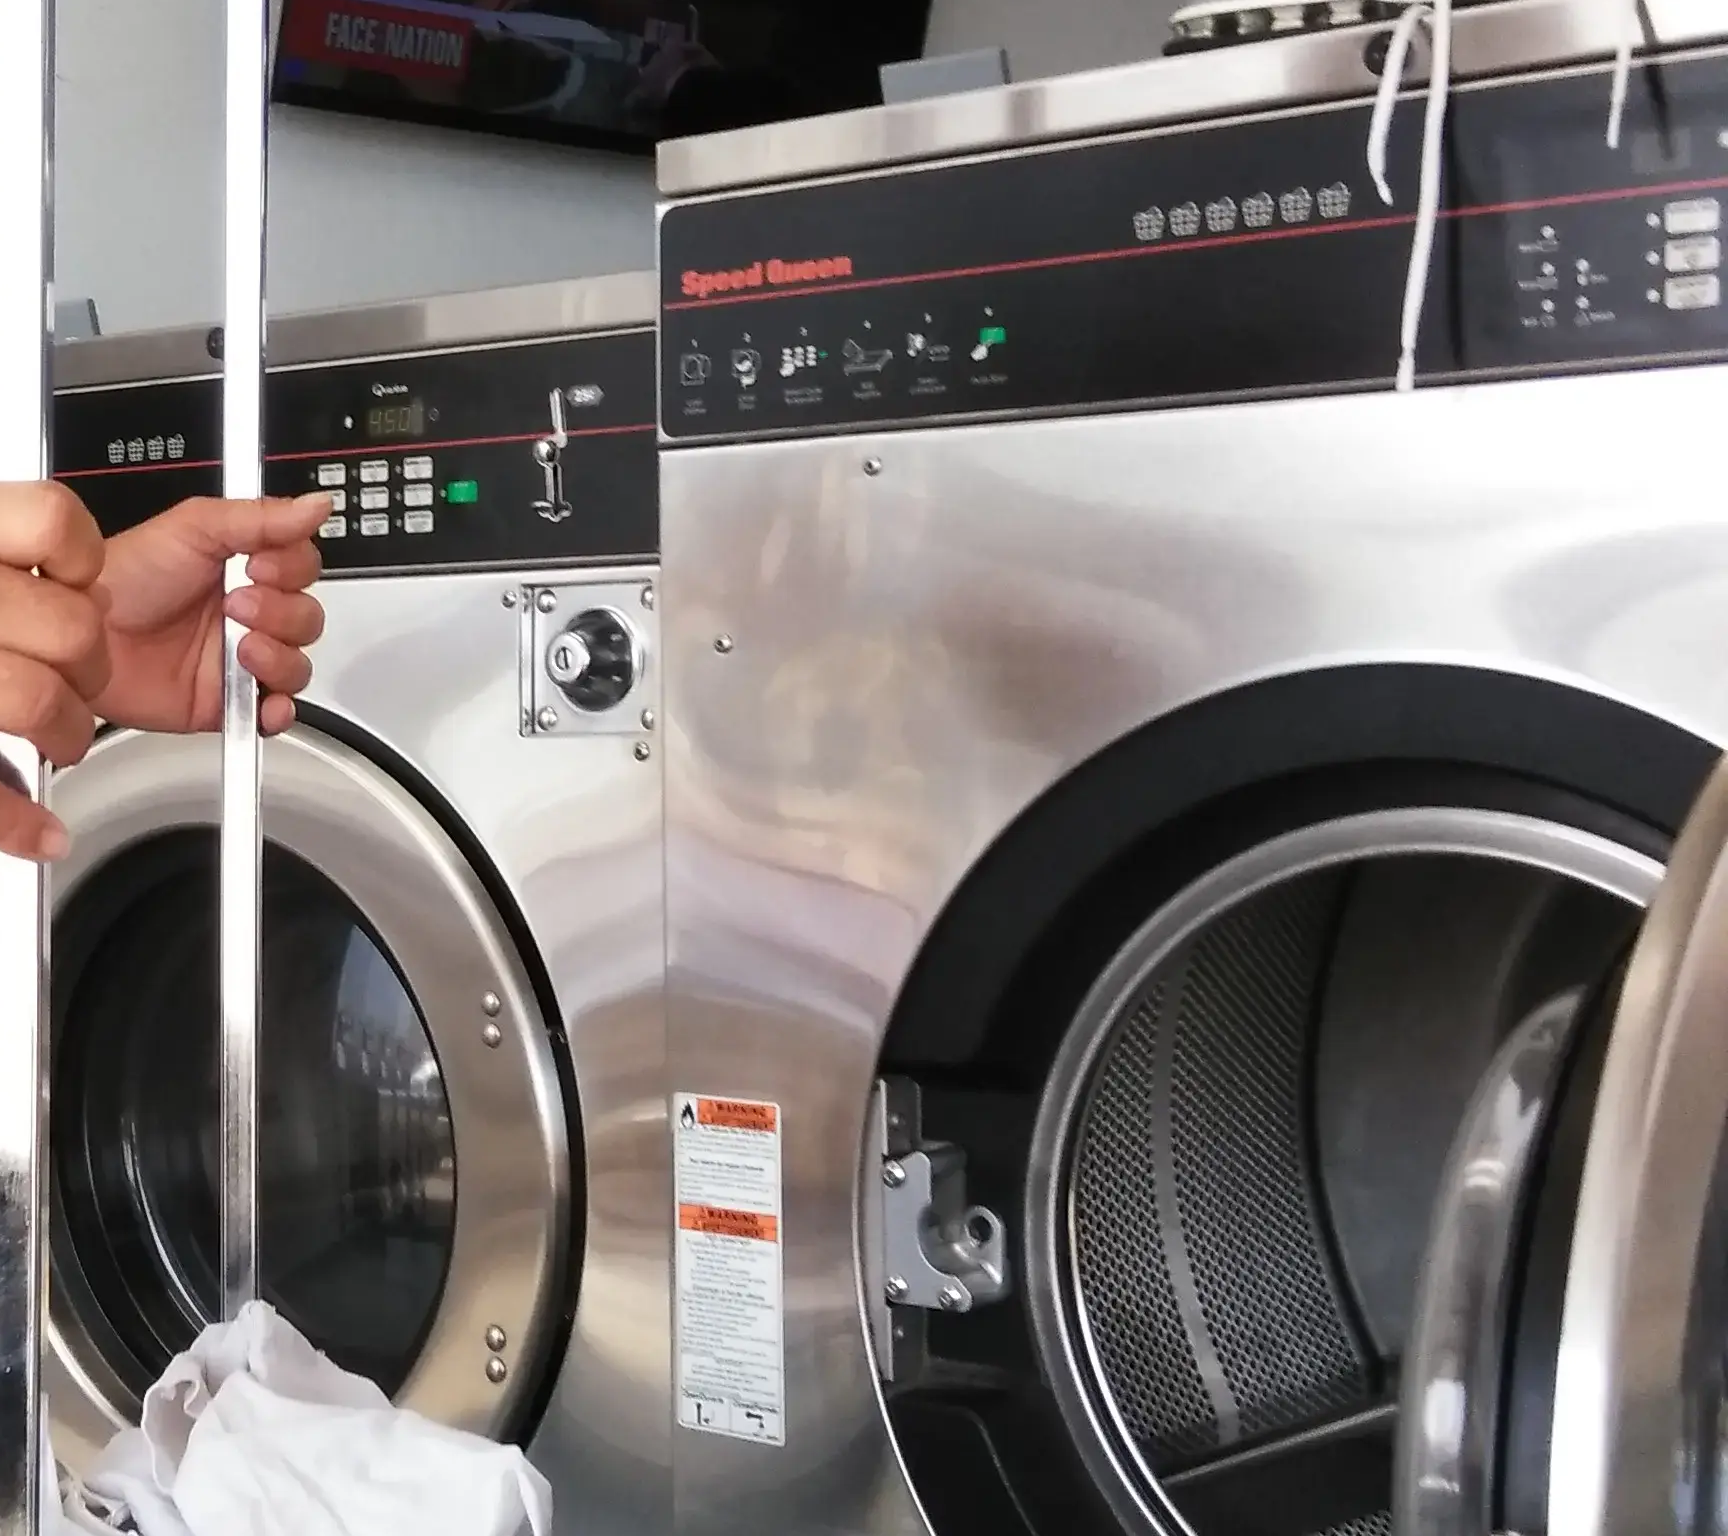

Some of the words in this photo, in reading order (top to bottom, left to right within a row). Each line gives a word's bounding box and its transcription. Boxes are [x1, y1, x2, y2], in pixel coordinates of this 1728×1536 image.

[323, 11, 380, 54] FACE
[383, 18, 464, 68] NATION
[680, 261, 764, 299] Speed
[766, 254, 853, 285] Queen
